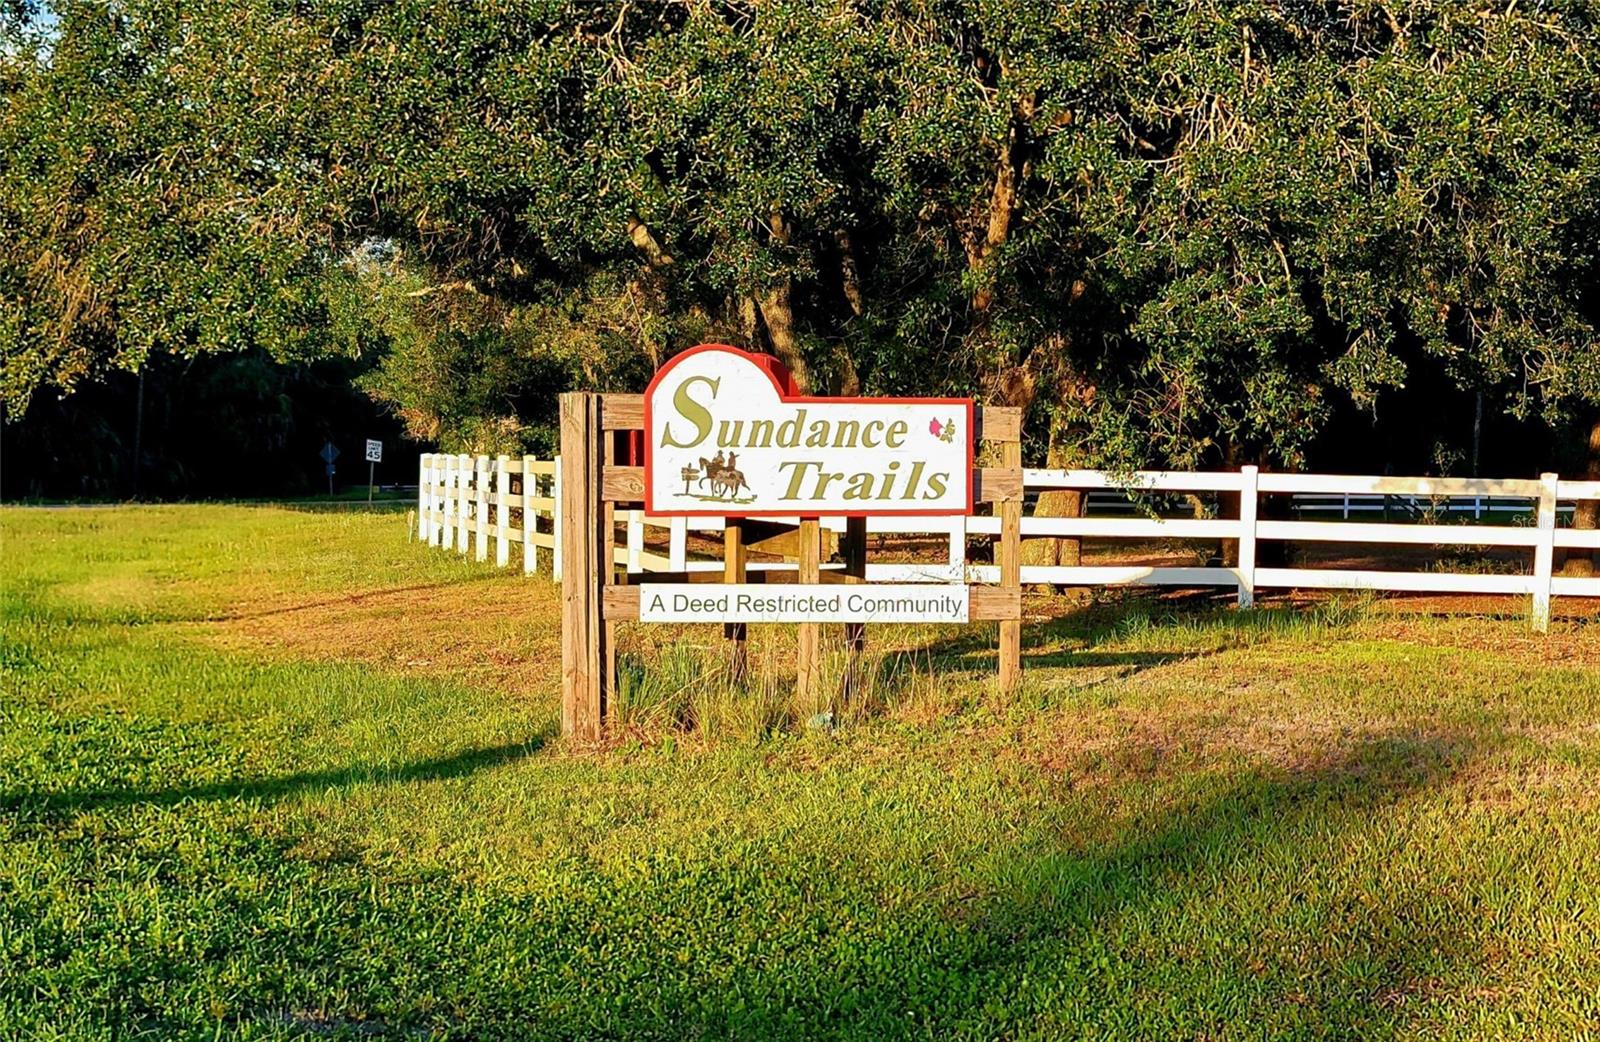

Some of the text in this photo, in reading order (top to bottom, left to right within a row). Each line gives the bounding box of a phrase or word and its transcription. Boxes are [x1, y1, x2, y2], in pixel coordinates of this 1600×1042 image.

[660, 375, 908, 449] Sundance
[367, 451, 380, 459] 45
[778, 461, 950, 501] Trails
[649, 594, 962, 618] A Deed Restricted Community
